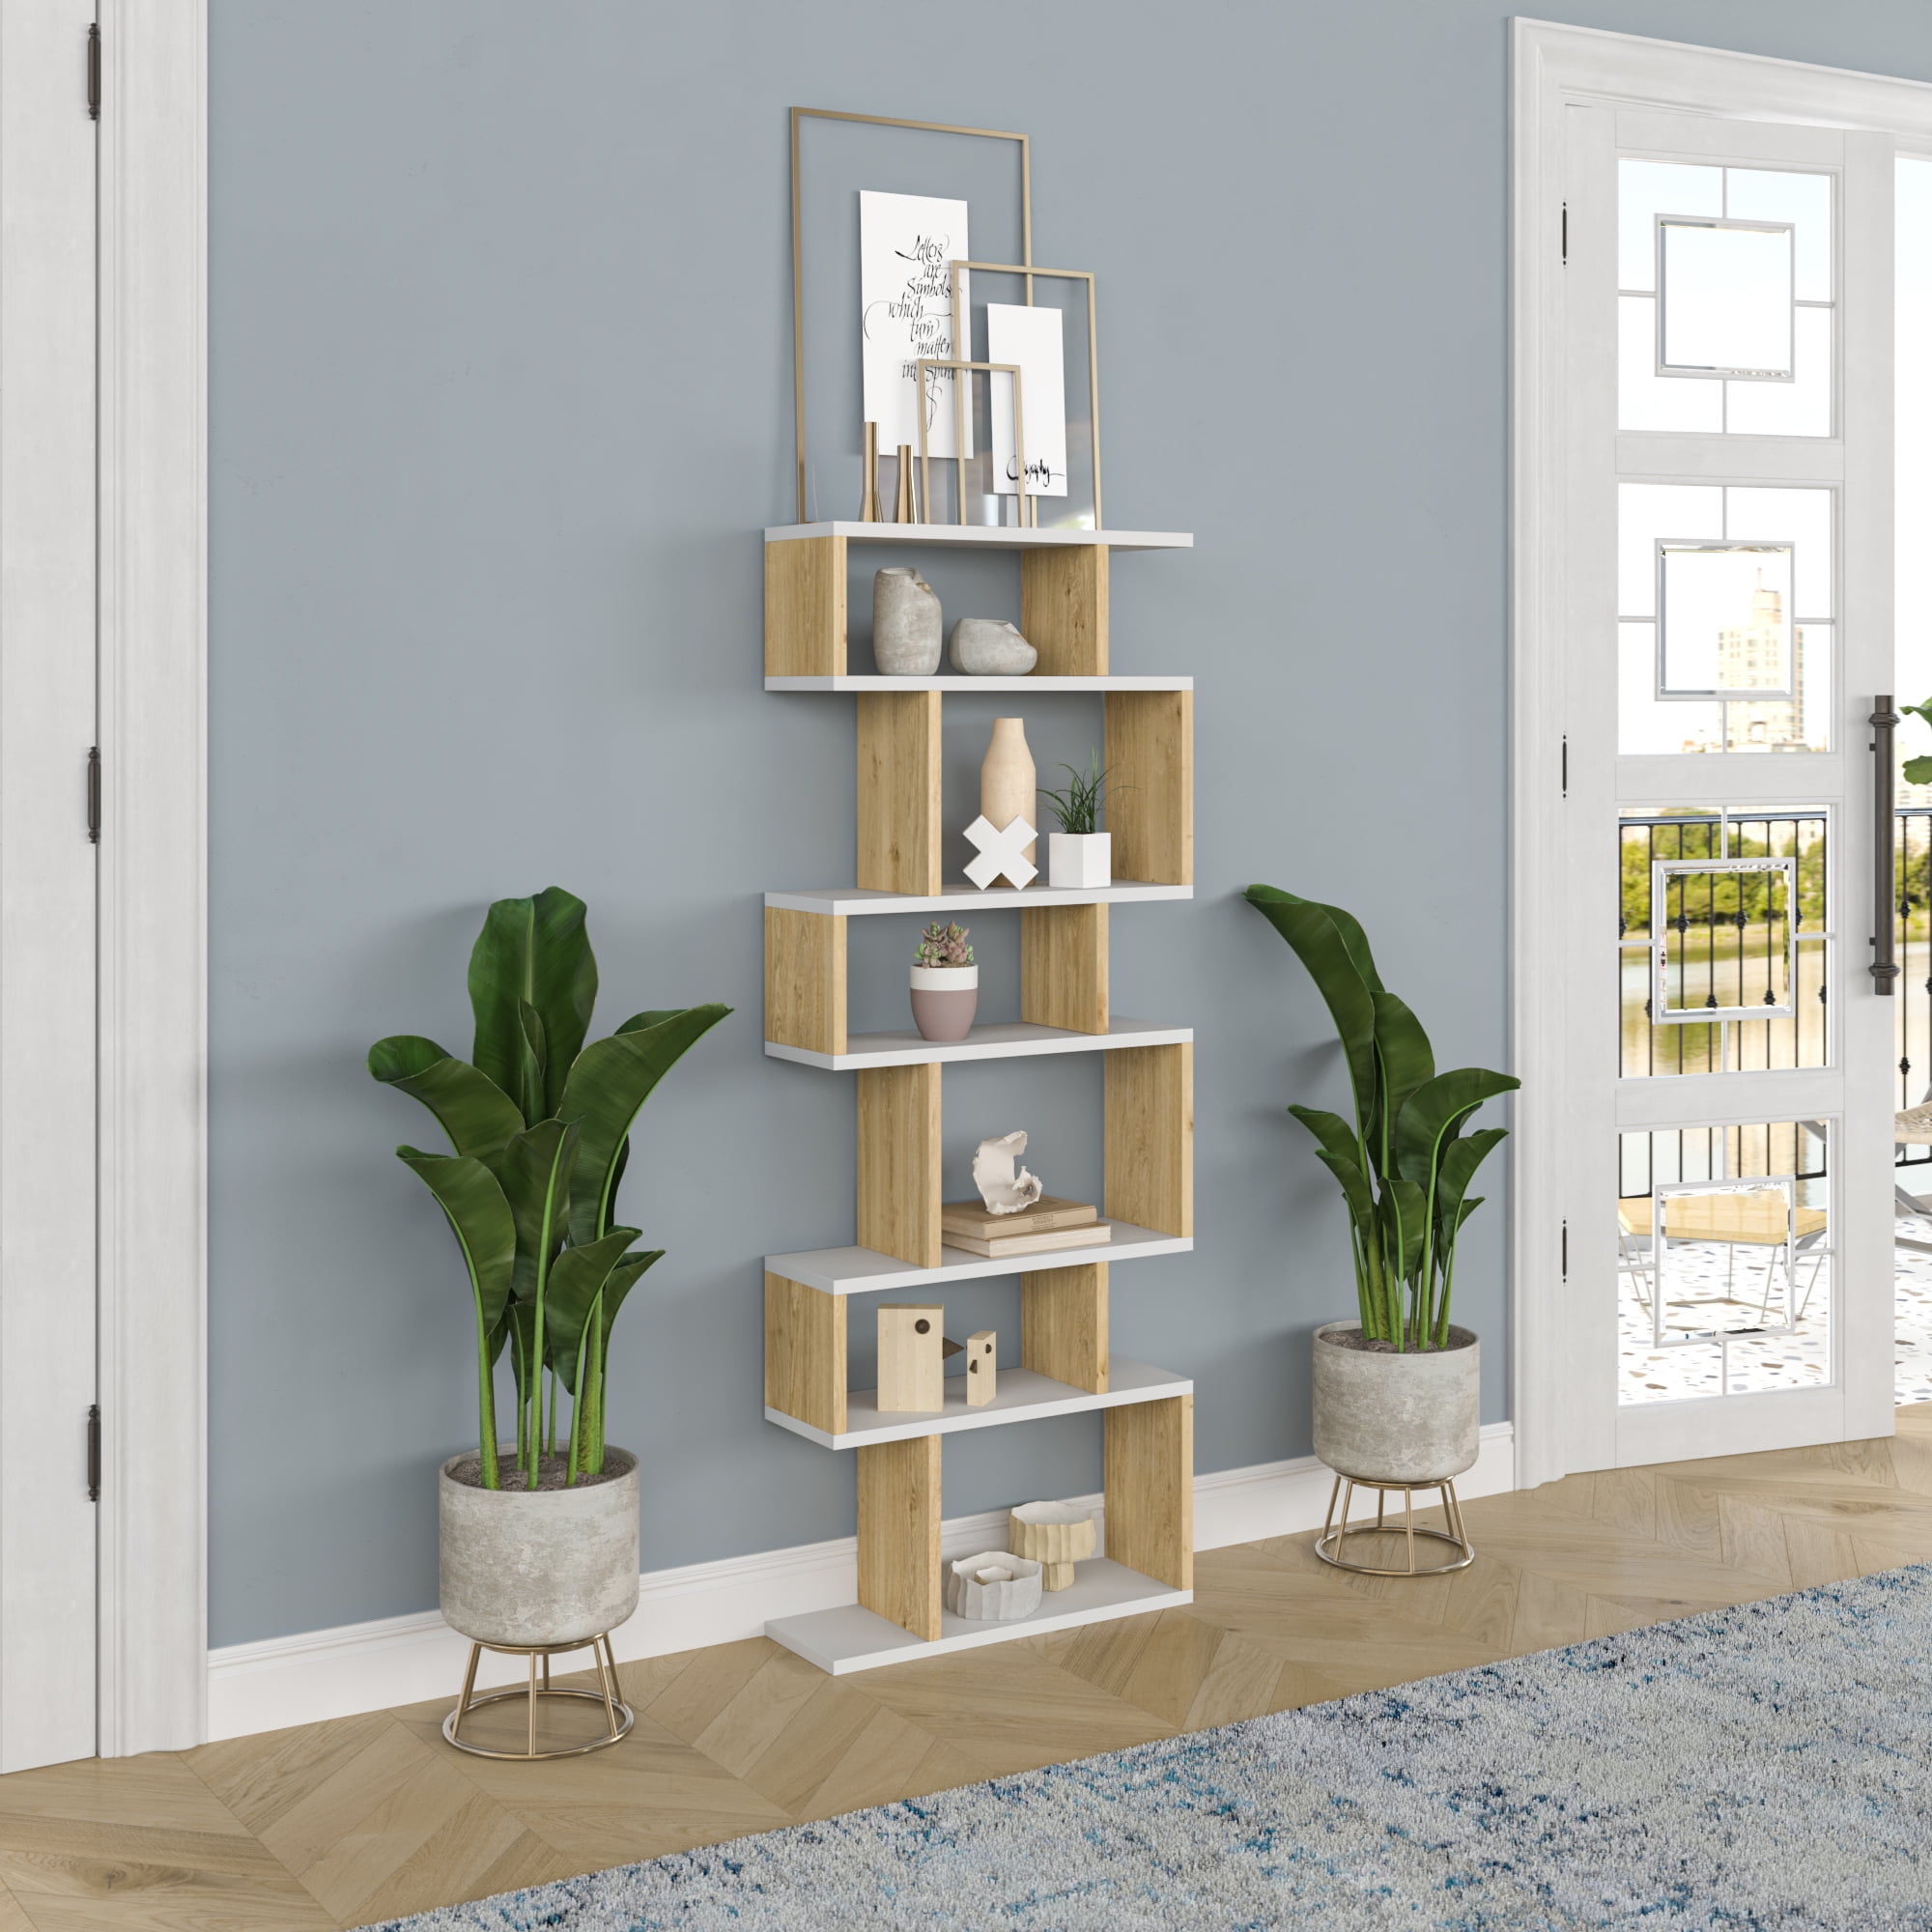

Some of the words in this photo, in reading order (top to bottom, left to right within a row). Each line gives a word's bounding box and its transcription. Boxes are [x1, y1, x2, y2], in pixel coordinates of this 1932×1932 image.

[895, 234, 950, 266] Letters
[923, 264, 946, 279] are
[914, 336, 950, 361] matter
[902, 359, 917, 382] int
